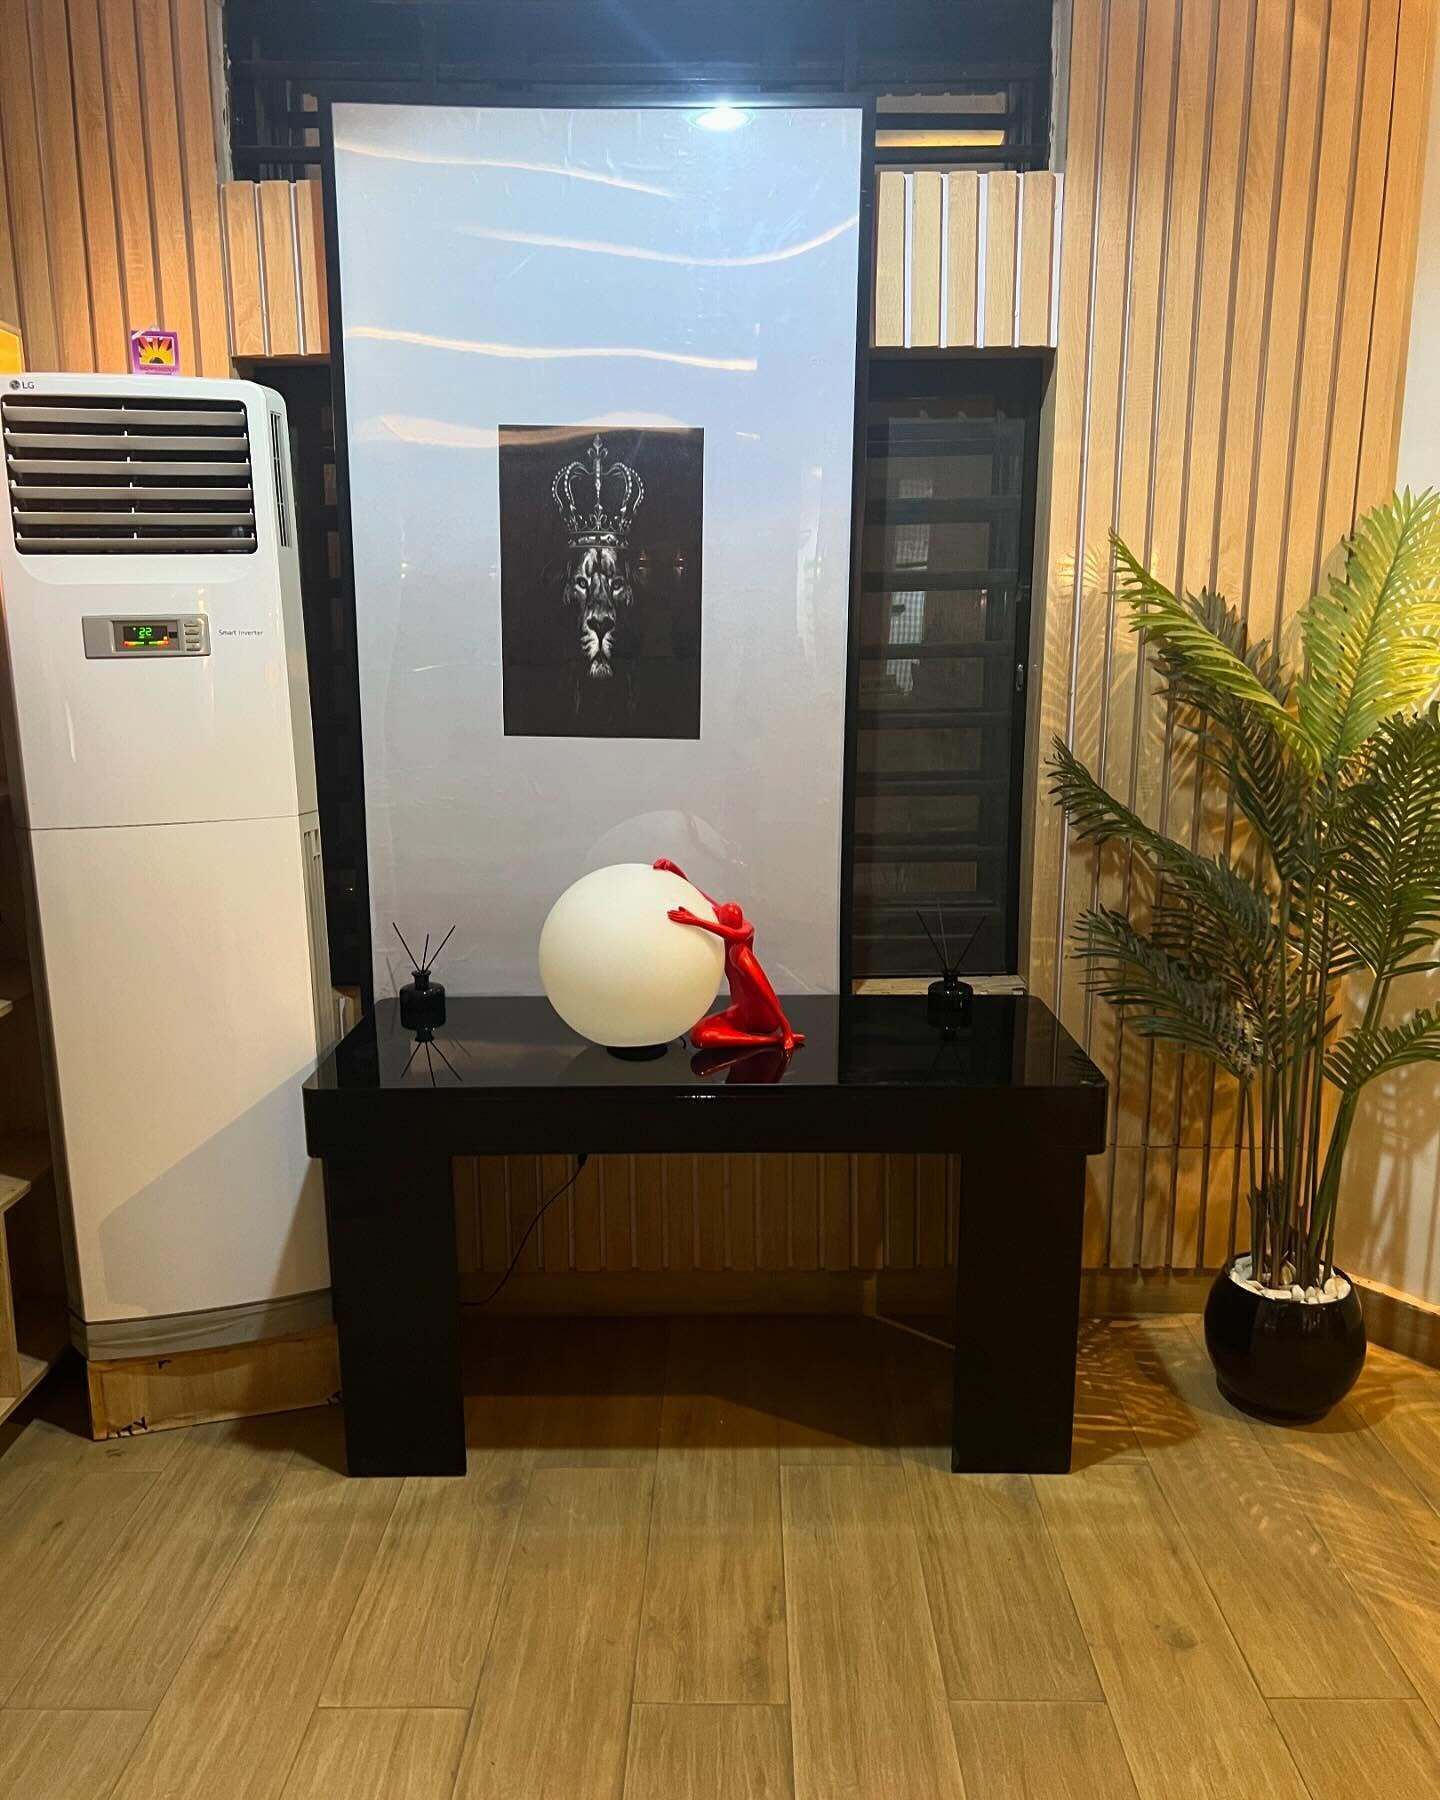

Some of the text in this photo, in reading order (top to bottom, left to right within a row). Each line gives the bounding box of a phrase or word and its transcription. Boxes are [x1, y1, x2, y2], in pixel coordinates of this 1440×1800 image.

[22, 381, 35, 389] LG
[138, 627, 152, 637] 22
[218, 629, 263, 637] Smart Inverter
